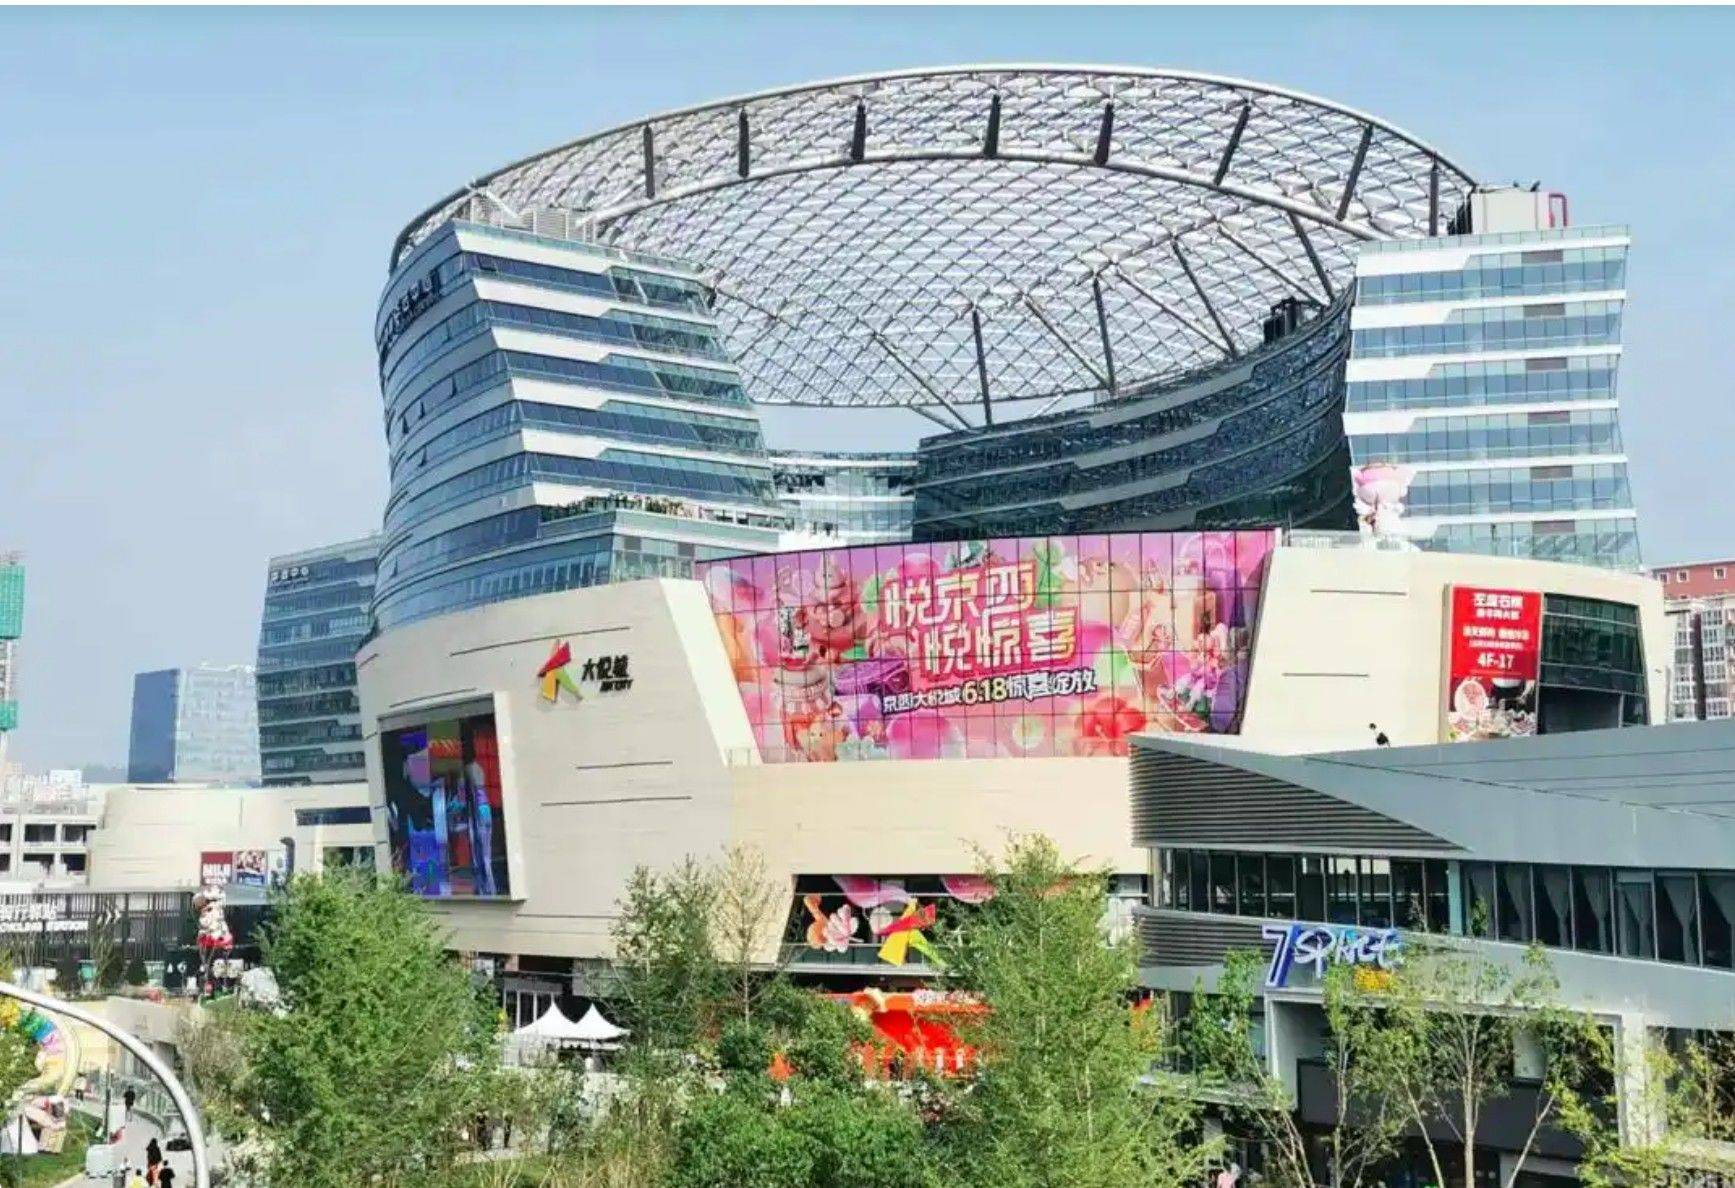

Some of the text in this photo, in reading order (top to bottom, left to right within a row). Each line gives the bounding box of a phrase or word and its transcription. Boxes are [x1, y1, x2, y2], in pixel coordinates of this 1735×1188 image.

[885, 563, 1035, 629] 悦京西
[923, 610, 1076, 675] 悦惊喜
